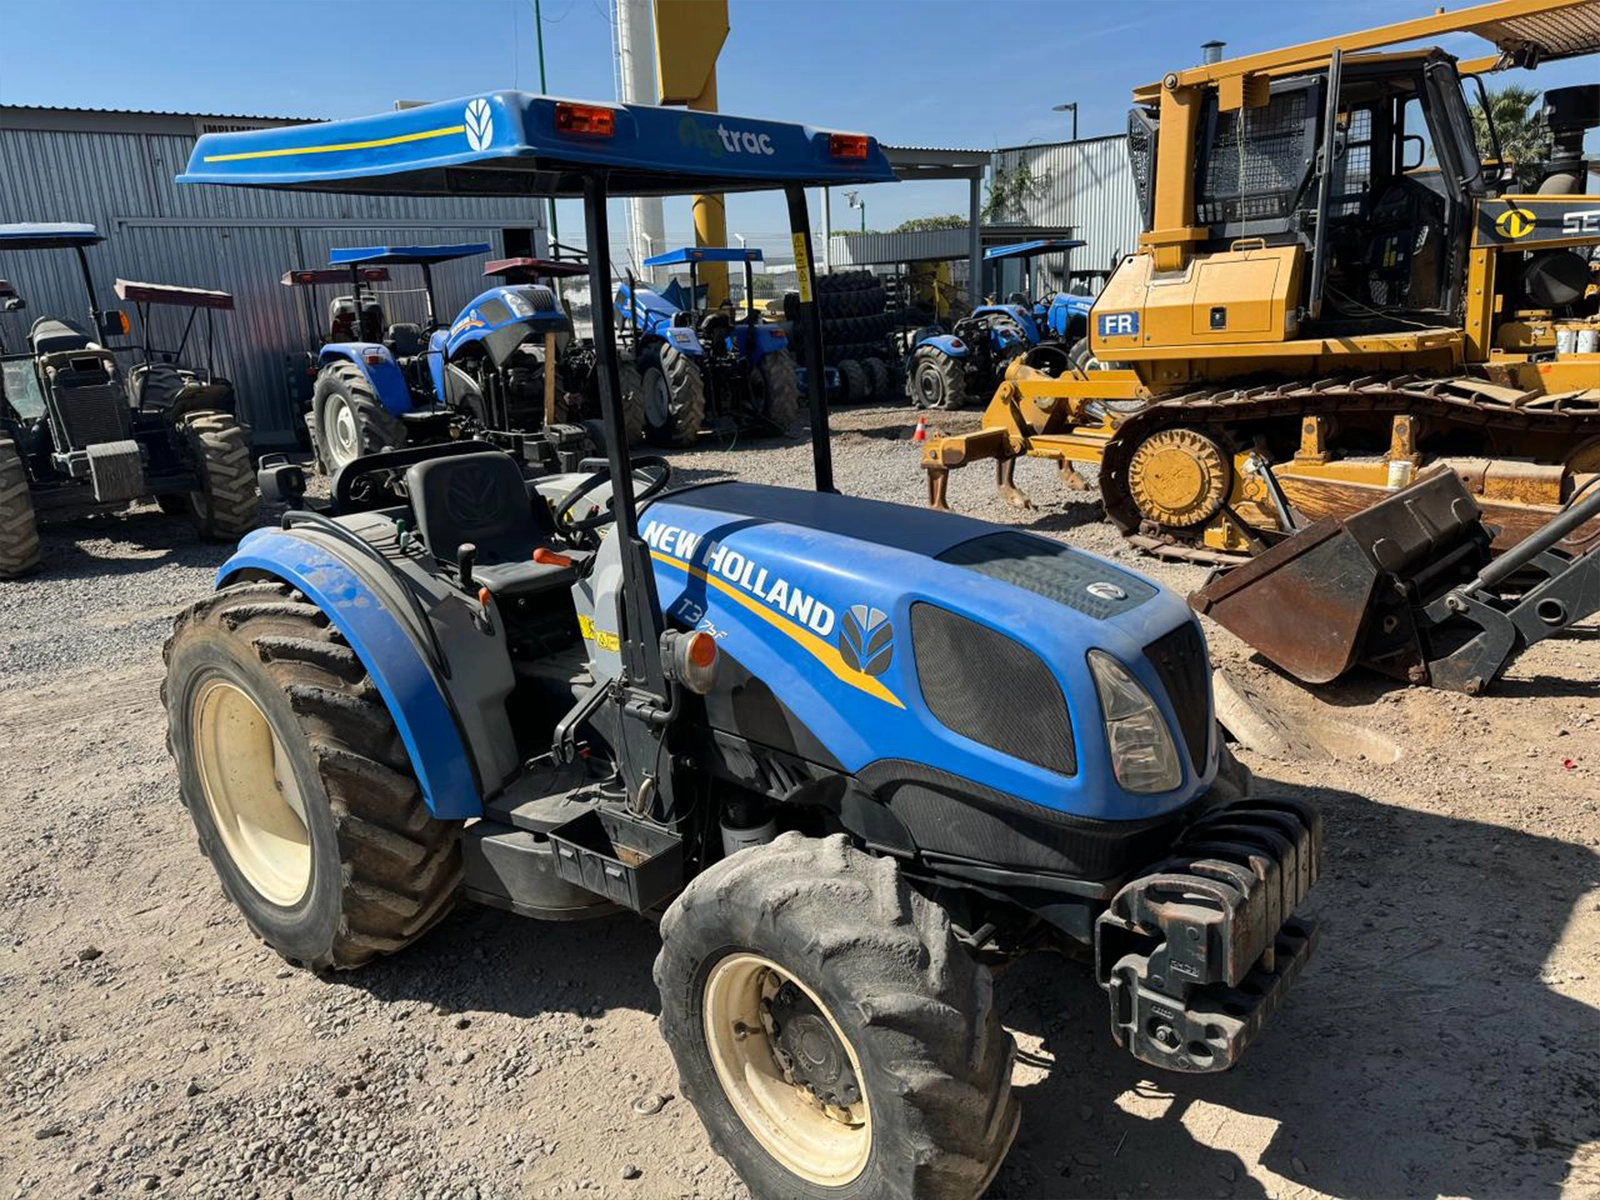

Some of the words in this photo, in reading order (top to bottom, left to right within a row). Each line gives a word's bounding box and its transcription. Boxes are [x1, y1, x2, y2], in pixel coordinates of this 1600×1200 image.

[1105, 314, 1133, 335] FR
[642, 520, 704, 560] NEW
[702, 540, 835, 637] HOLLAND
